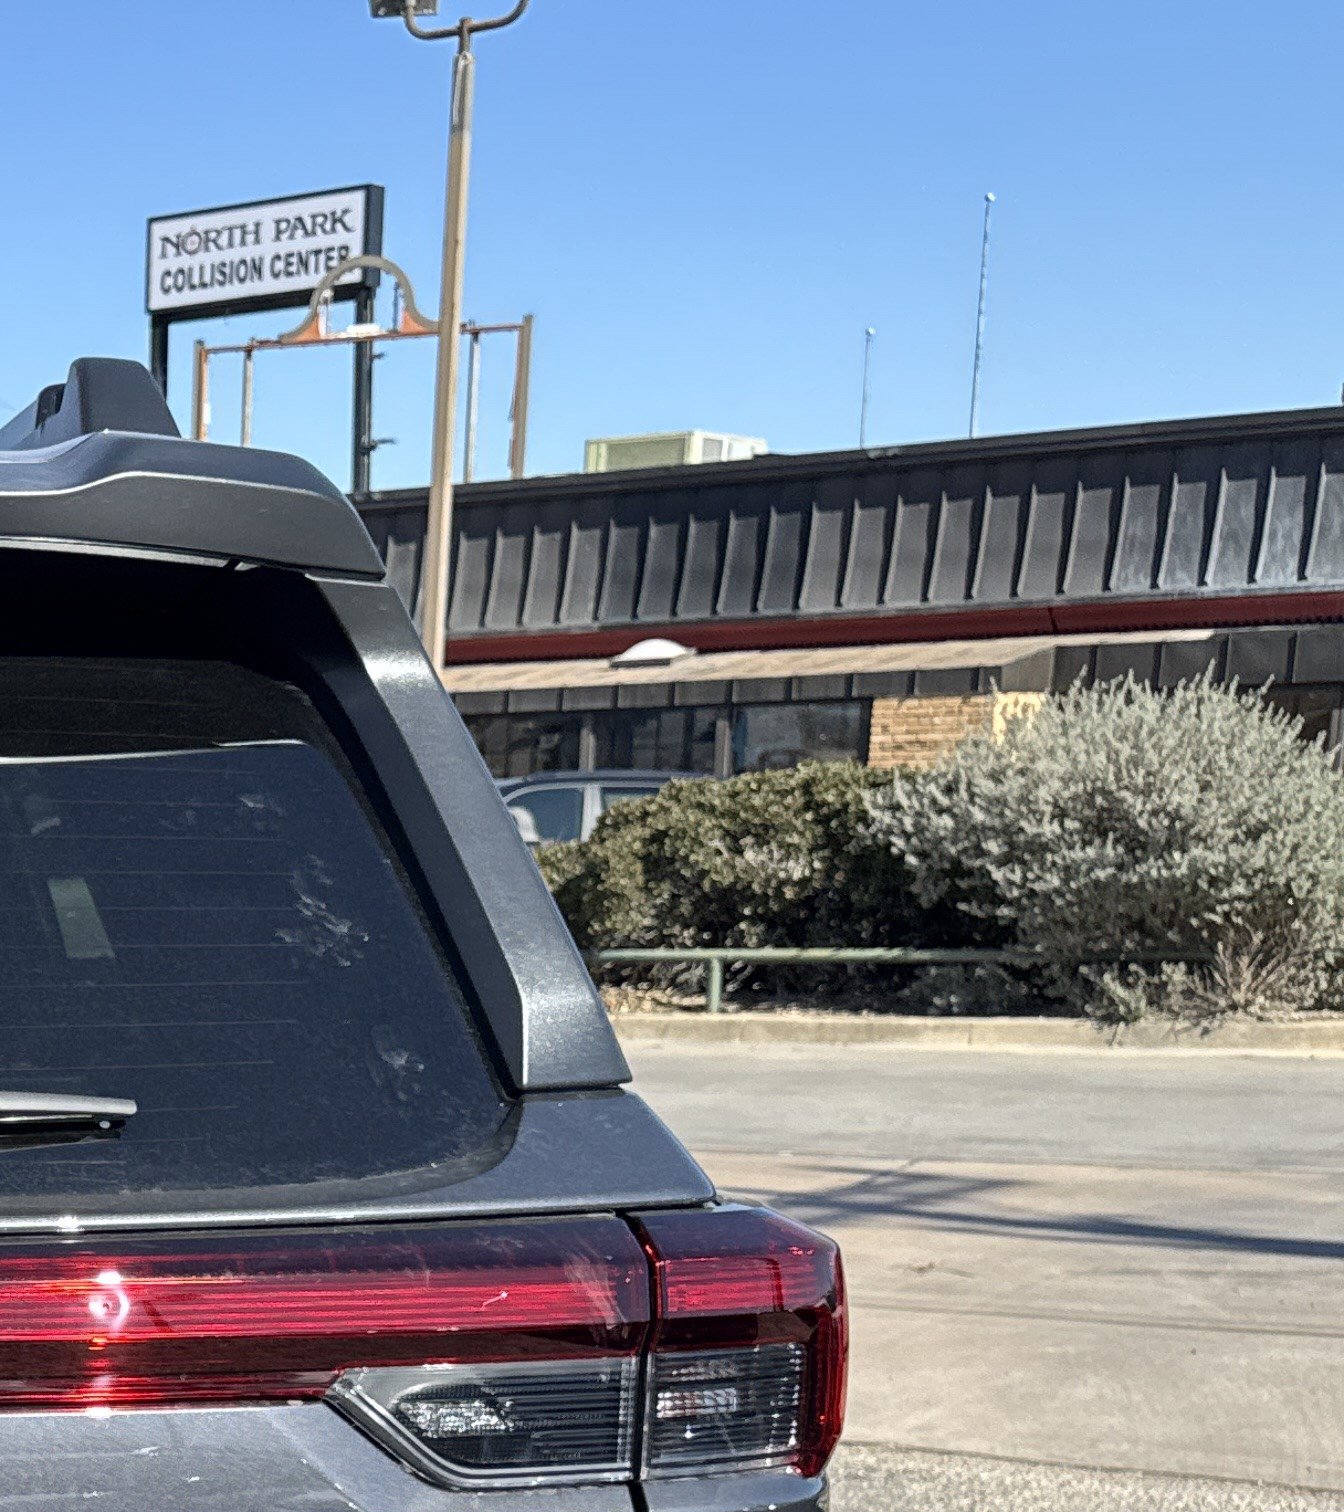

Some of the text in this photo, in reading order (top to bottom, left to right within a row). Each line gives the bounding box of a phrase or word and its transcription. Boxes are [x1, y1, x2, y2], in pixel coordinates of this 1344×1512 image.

[159, 208, 355, 259] NORTH PARK
[160, 256, 264, 294] COLLISION
